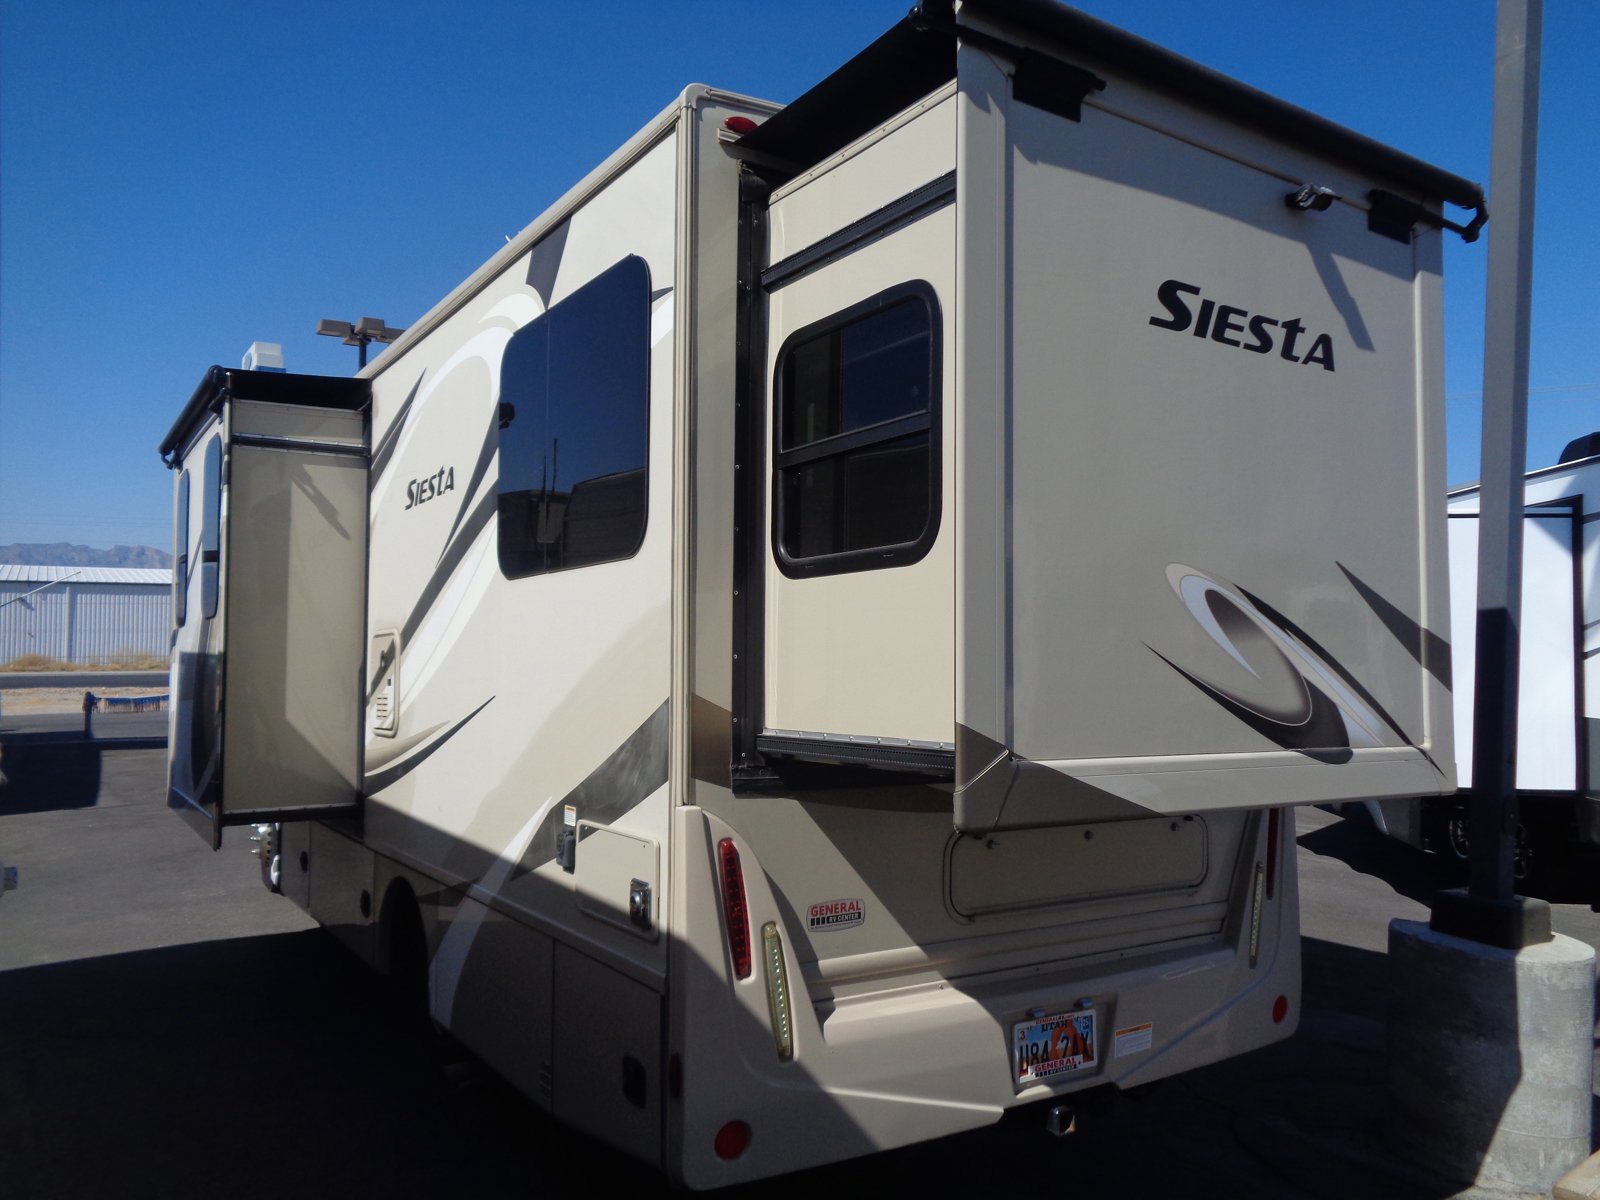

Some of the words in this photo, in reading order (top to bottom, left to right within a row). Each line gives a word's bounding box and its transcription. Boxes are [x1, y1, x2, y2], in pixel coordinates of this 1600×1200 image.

[811, 901, 862, 917] GENERAL
[838, 912, 859, 922] CENTER
[1041, 1019, 1068, 1033] UTAH
[1035, 1057, 1077, 1072] GENERAL
